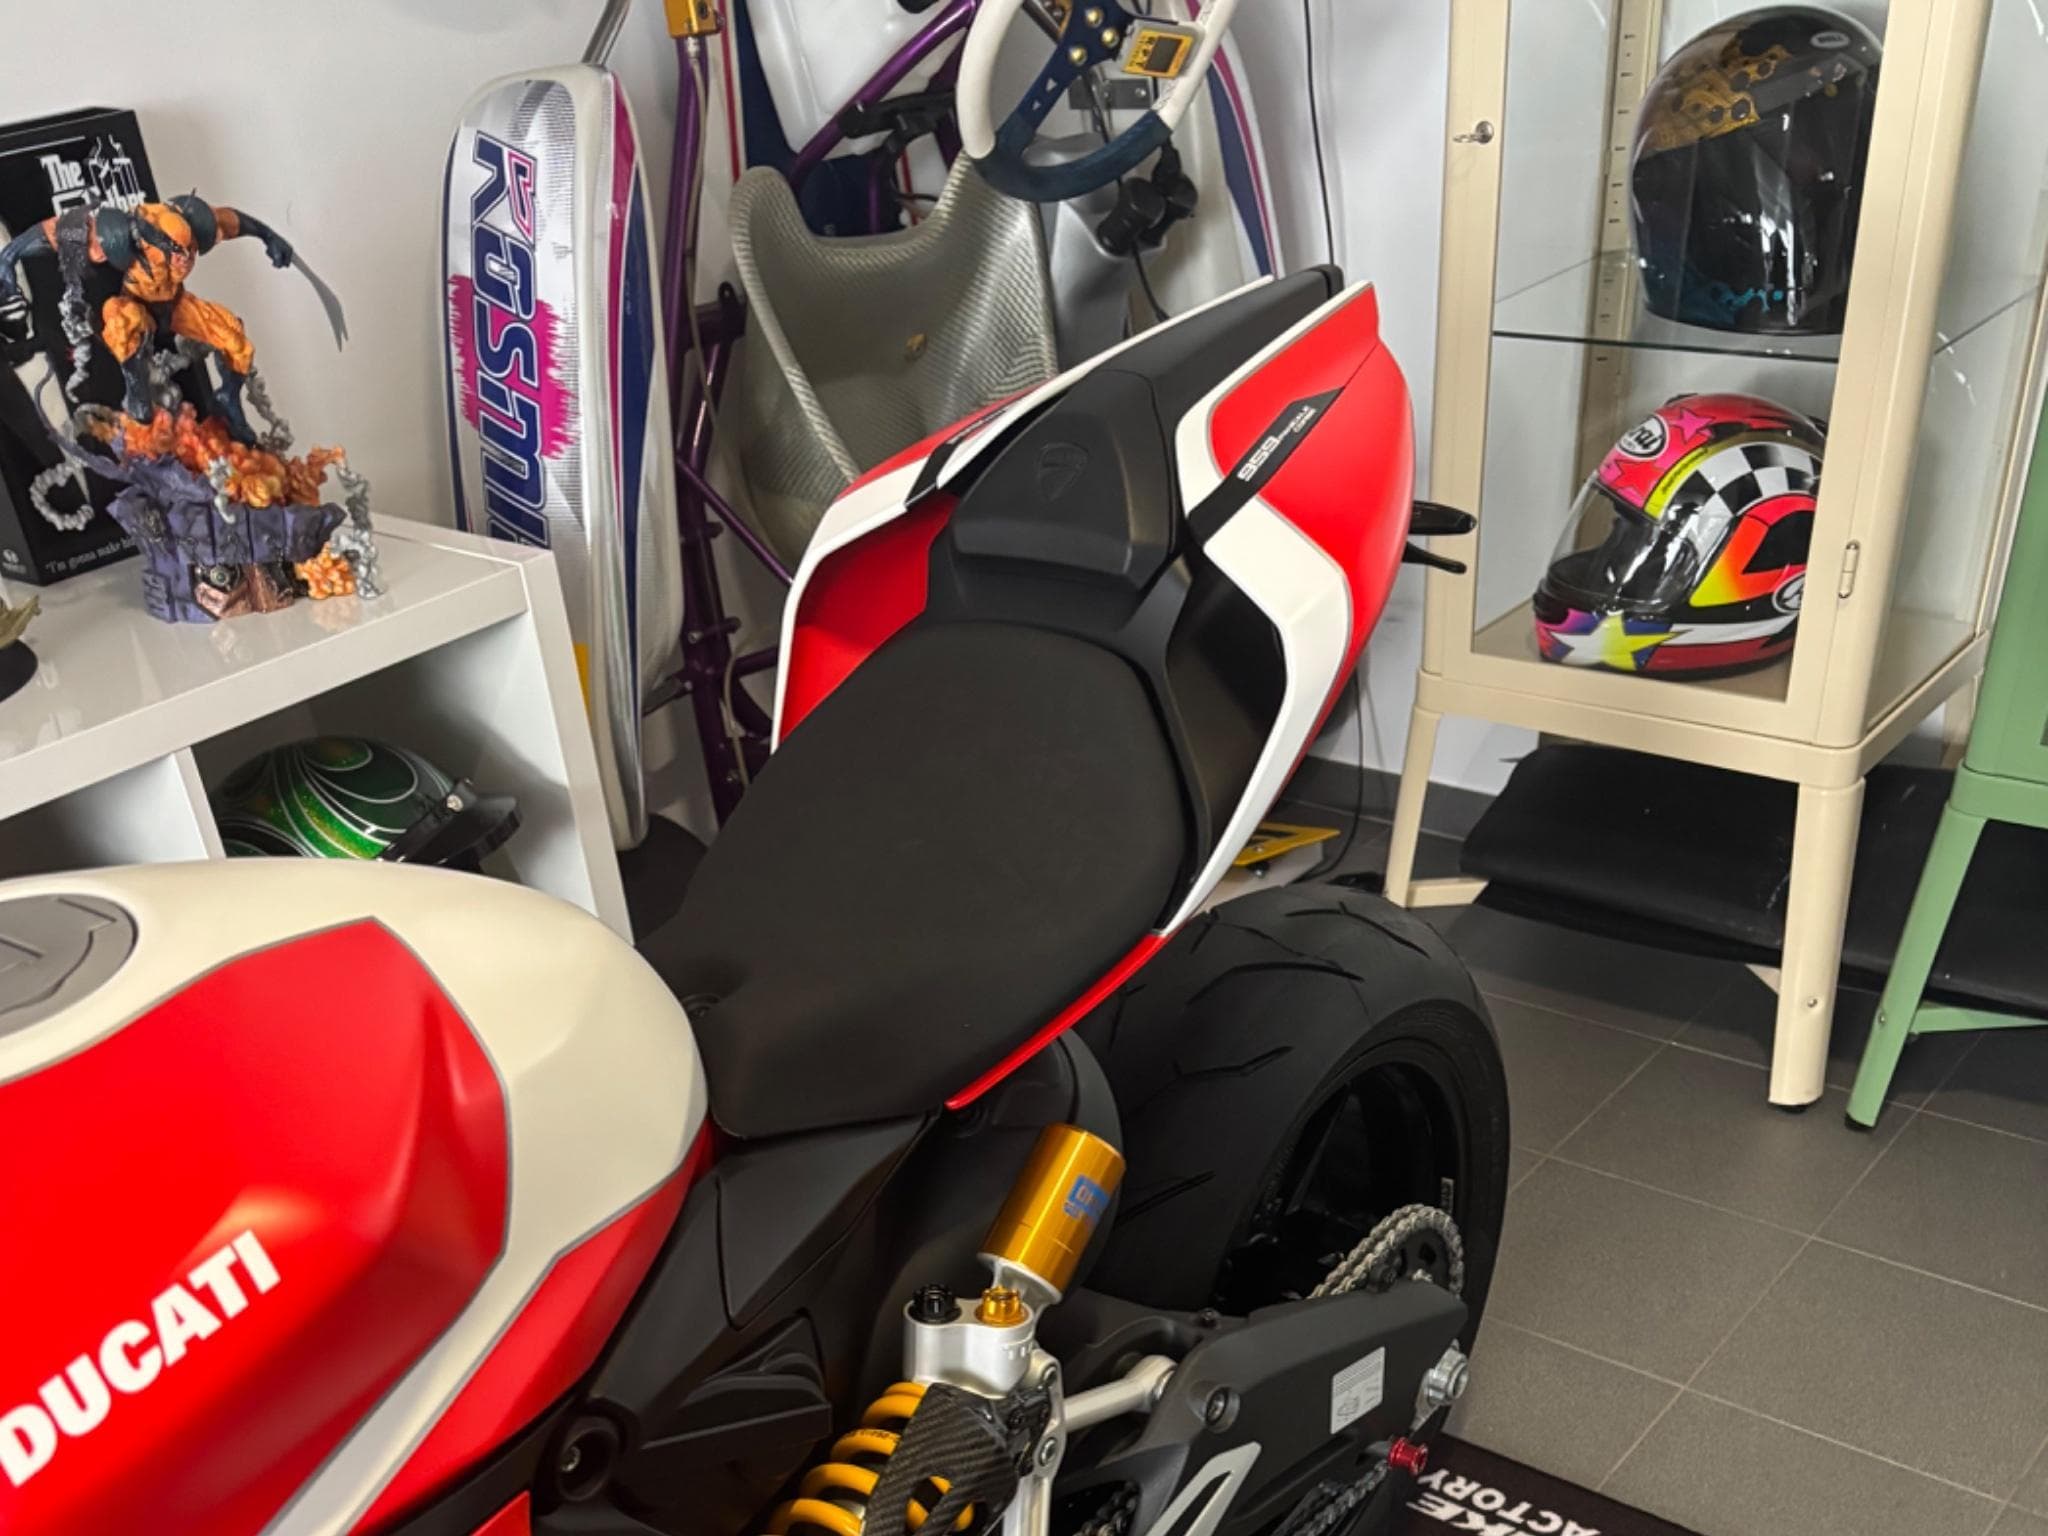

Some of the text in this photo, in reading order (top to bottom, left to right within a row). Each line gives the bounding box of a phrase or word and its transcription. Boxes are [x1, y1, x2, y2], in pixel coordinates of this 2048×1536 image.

[41, 154, 85, 194] The
[0, 1229, 281, 1488] DUCATI
[1406, 1492, 1534, 1536] KE
